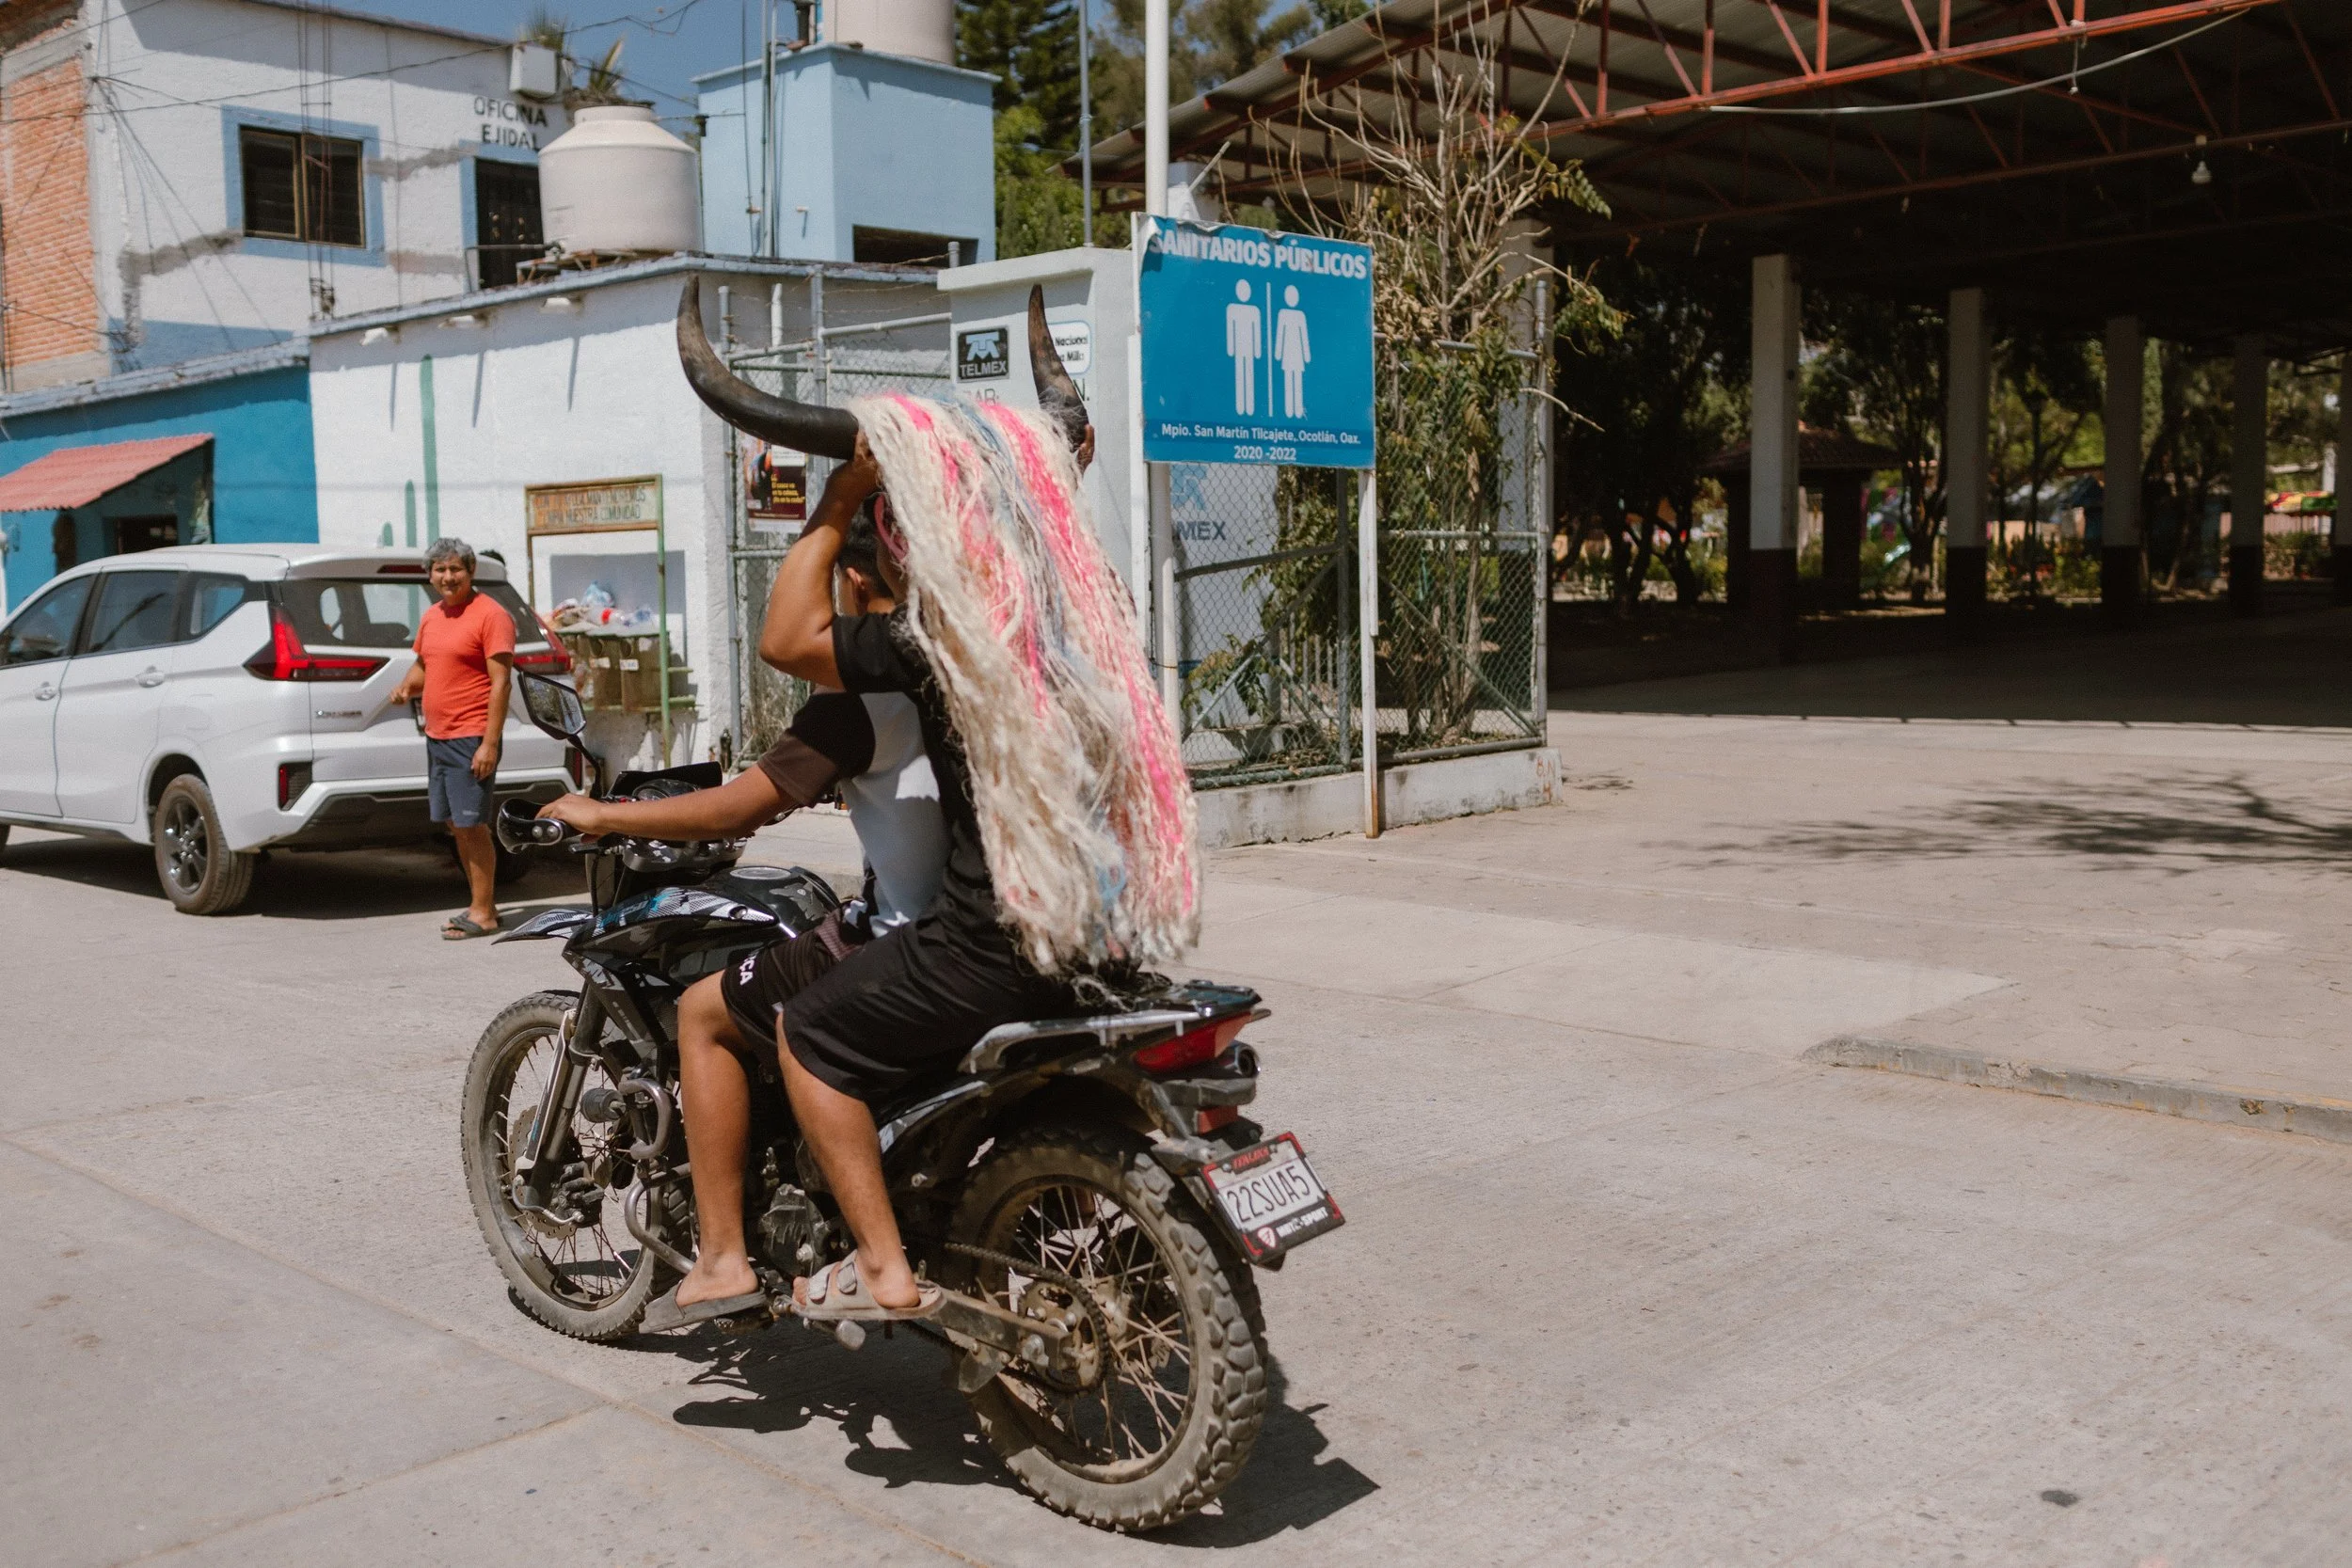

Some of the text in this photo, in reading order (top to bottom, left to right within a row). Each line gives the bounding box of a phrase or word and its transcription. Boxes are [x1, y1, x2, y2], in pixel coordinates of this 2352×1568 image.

[474, 96, 548, 127] OFICINA
[482, 124, 542, 152] EJIDAL
[1149, 229, 1367, 279] SANITARIOS PÚBLICOS
[960, 360, 1008, 376] TELMEX
[1161, 423, 1192, 438] Mpio.
[1194, 424, 1214, 437] San
[1216, 425, 1249, 440] Martín
[1298, 429, 1338, 444] Ocotlán,
[1340, 432, 1361, 445] Oax.
[1234, 445, 1263, 460] 2020
[1227, 1165, 1311, 1223] 22SUA5
